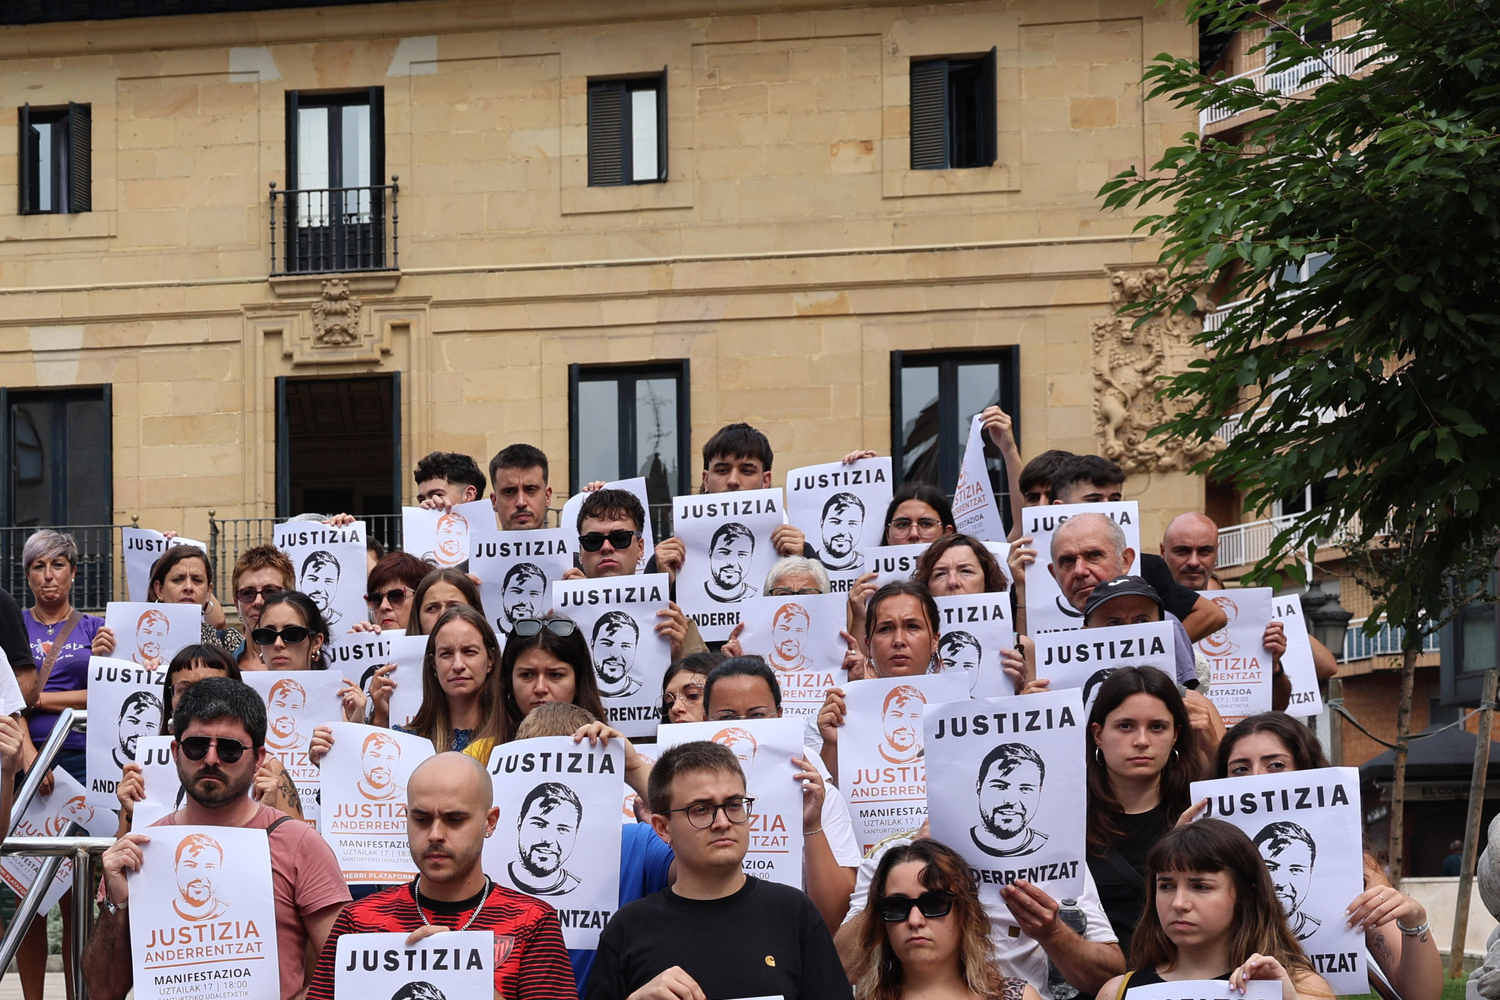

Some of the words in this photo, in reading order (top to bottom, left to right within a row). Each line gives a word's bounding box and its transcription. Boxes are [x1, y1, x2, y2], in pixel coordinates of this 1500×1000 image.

[794, 468, 886, 491] JUSTIZIA
[681, 498, 777, 520] JUSTIZIA
[280, 530, 360, 548] JUSTIZIA
[476, 539, 567, 558] JUSTIZIA
[561, 586, 662, 607] JUSTIZIA
[943, 604, 1004, 624] TIZIA
[1044, 636, 1165, 666] JUSTIZIA
[95, 667, 166, 686] JUSTIZ
[1212, 671, 1263, 681] RENTZAT
[1205, 688, 1252, 697] FESTAZIOA
[934, 706, 1076, 739] JUSTIZIA
[492, 752, 615, 775] JUSTIZIA
[851, 785, 925, 798] ANDERREN
[1202, 784, 1349, 818] JUSTIZIA
[333, 803, 407, 818] JUSTIZ
[860, 807, 928, 818] MANIFESTAZ
[331, 820, 407, 830] ANDERRENT
[864, 818, 902, 827] UZTAILAK
[971, 860, 1078, 886] DERRENTZAT
[146, 920, 260, 948] JUSTIZIA
[144, 942, 263, 963] ANDERRENTZAT
[346, 948, 483, 972] JUSTIZIA
[154, 968, 251, 985] MANIFESTAZIOA
[159, 984, 201, 996] UZTAILAK
[203, 983, 213, 991] 17
[224, 980, 248, 989] 18:00
[205, 990, 250, 1000] UDALETXETIK
